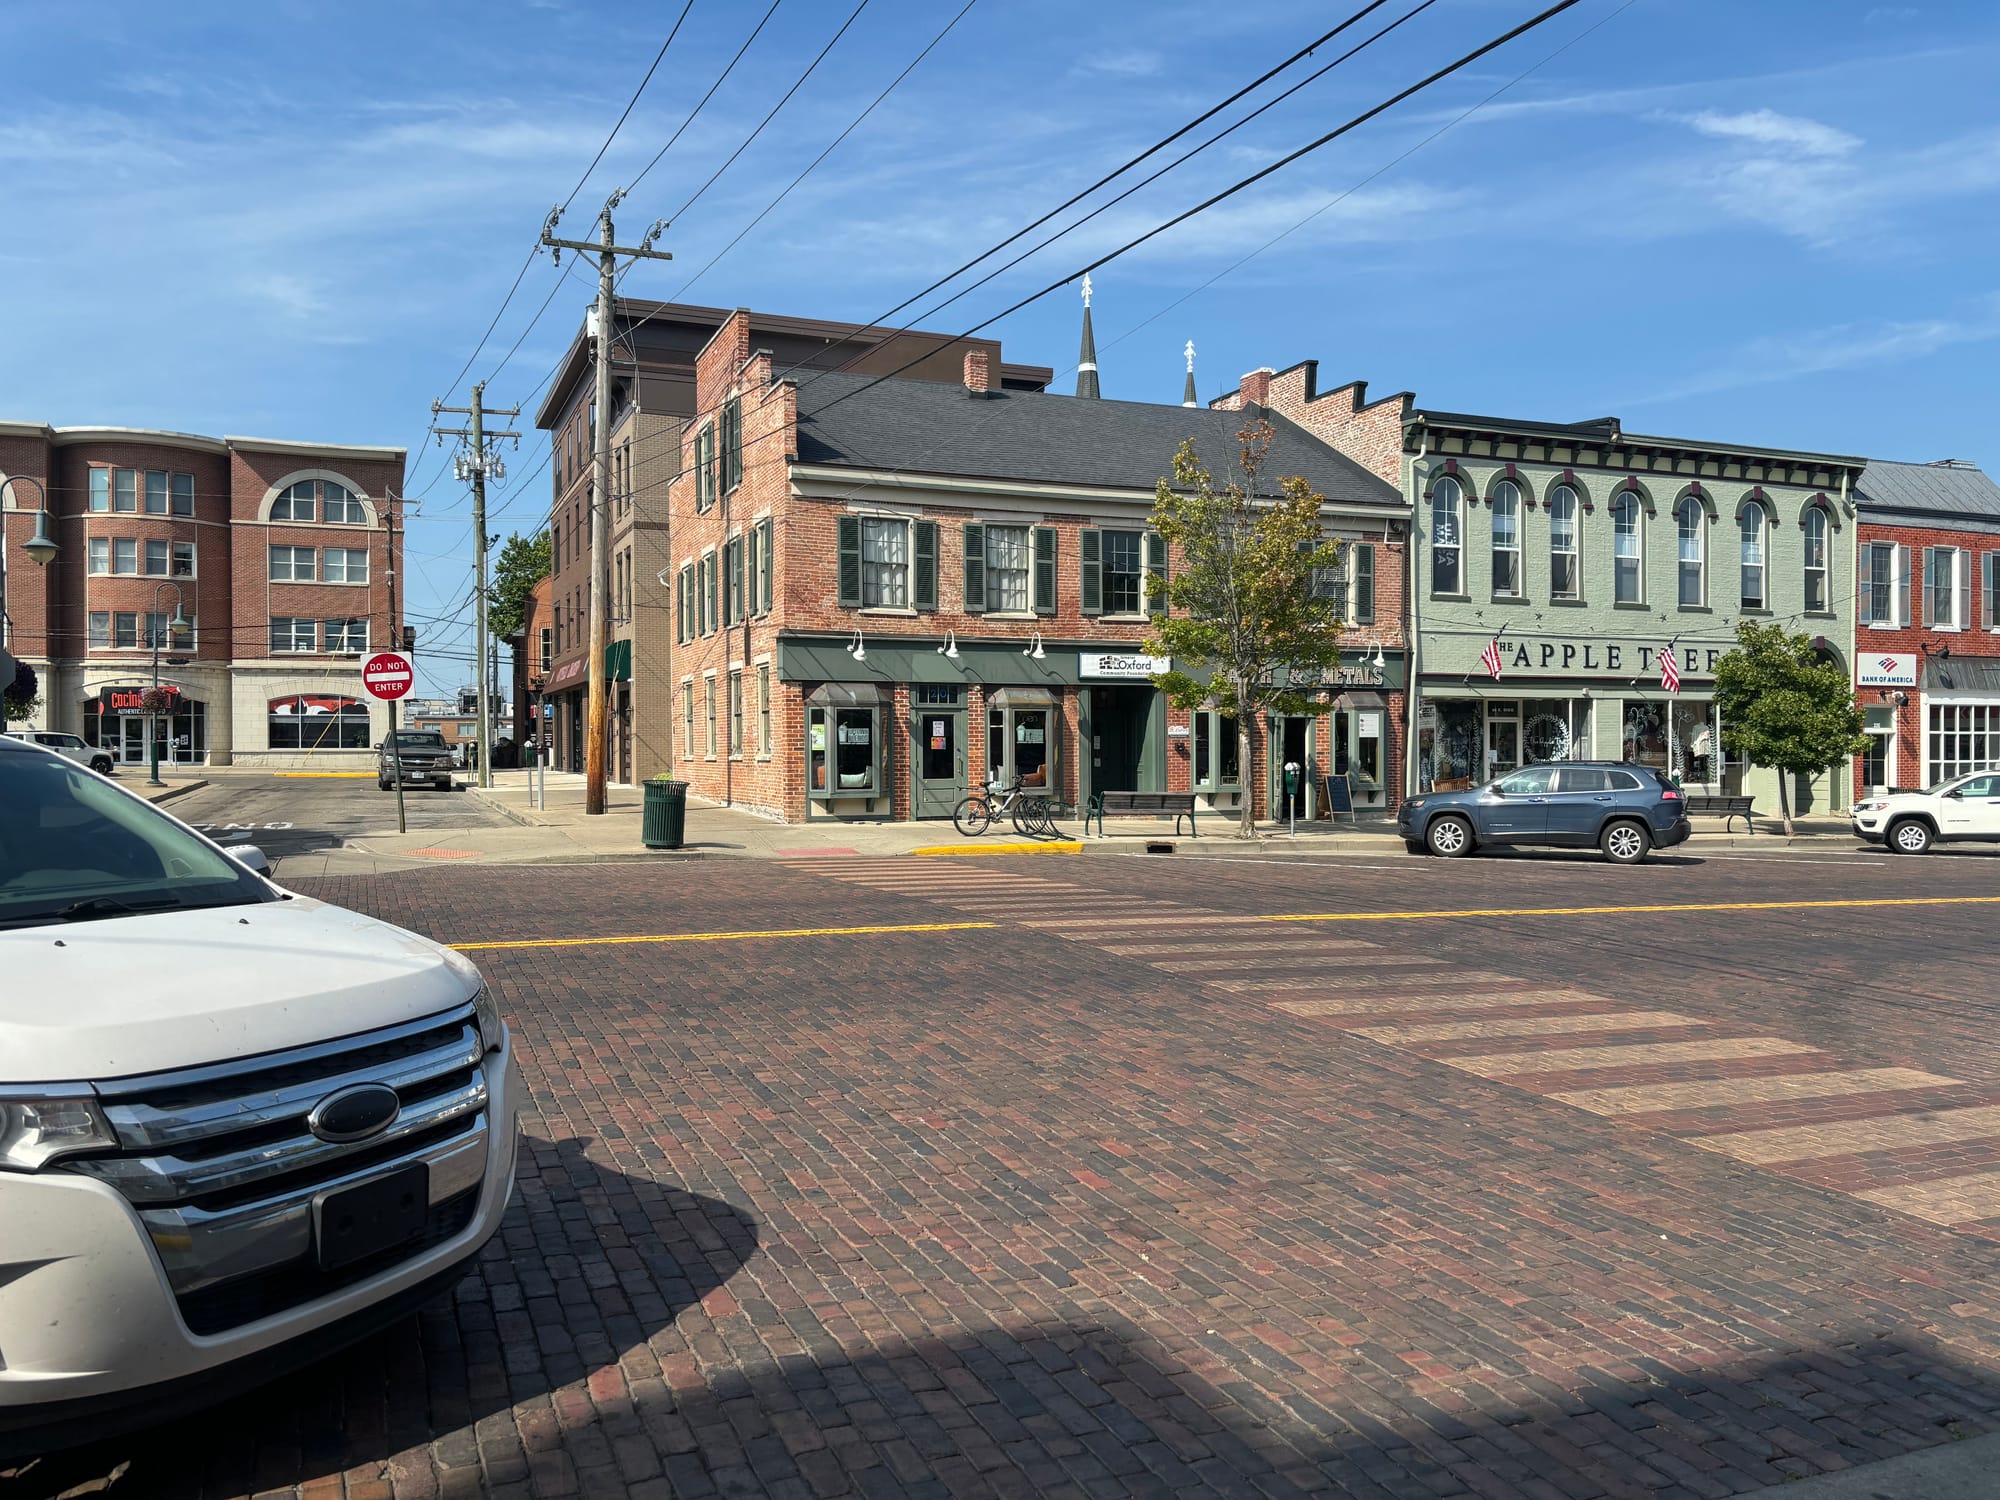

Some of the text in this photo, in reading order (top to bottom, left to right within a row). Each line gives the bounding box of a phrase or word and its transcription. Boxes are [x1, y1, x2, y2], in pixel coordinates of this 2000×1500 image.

[1496, 642, 1720, 672] HE APPLE TEE
[370, 662, 405, 671] DO NOT
[1119, 659, 1151, 670] Oxford
[1320, 666, 1383, 685] METALS
[375, 683, 403, 692] ENTER
[189, 822, 294, 831] ONL
